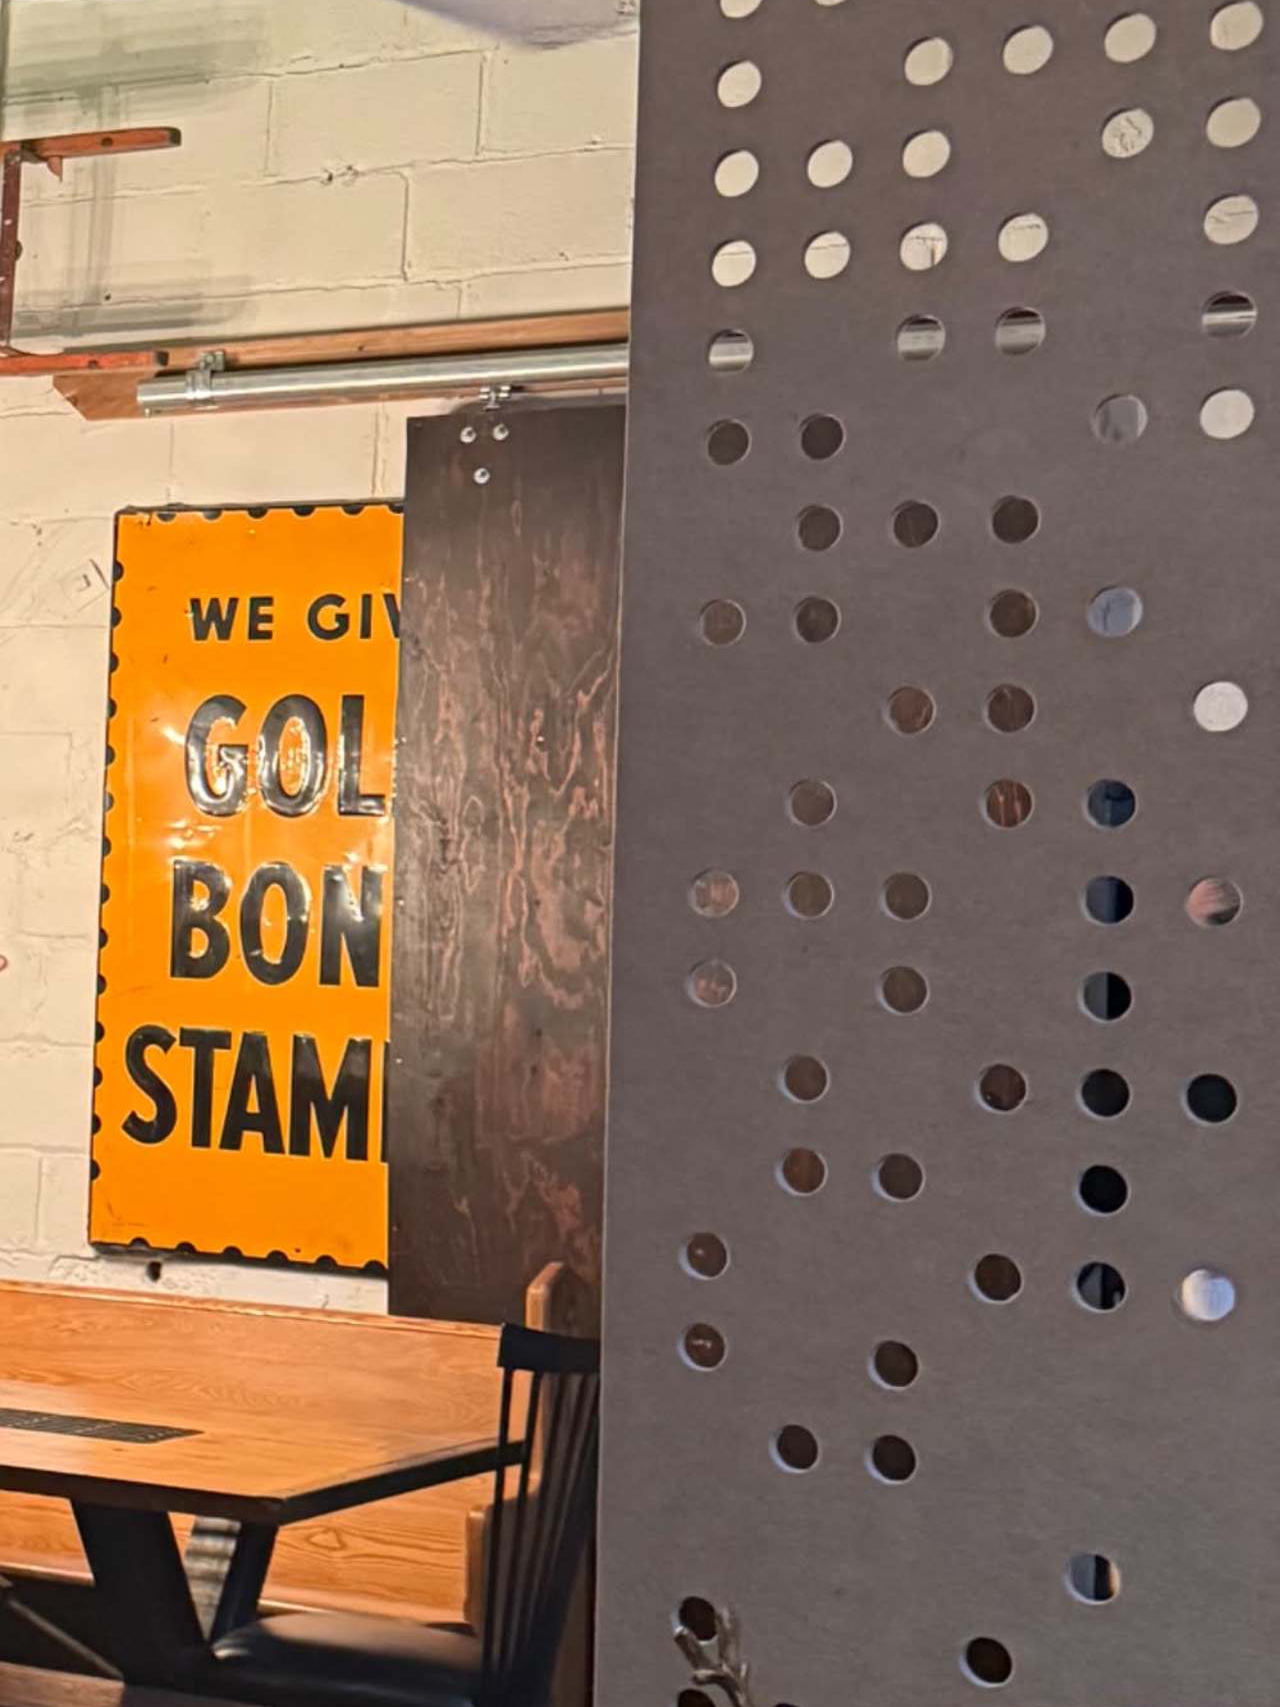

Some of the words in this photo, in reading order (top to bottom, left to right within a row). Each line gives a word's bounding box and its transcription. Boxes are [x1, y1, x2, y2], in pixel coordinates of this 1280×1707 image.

[190, 596, 274, 641] WE
[307, 593, 401, 640] GIV
[184, 693, 386, 818] GOL
[170, 859, 384, 988] BON
[121, 1024, 390, 1164] STAM
